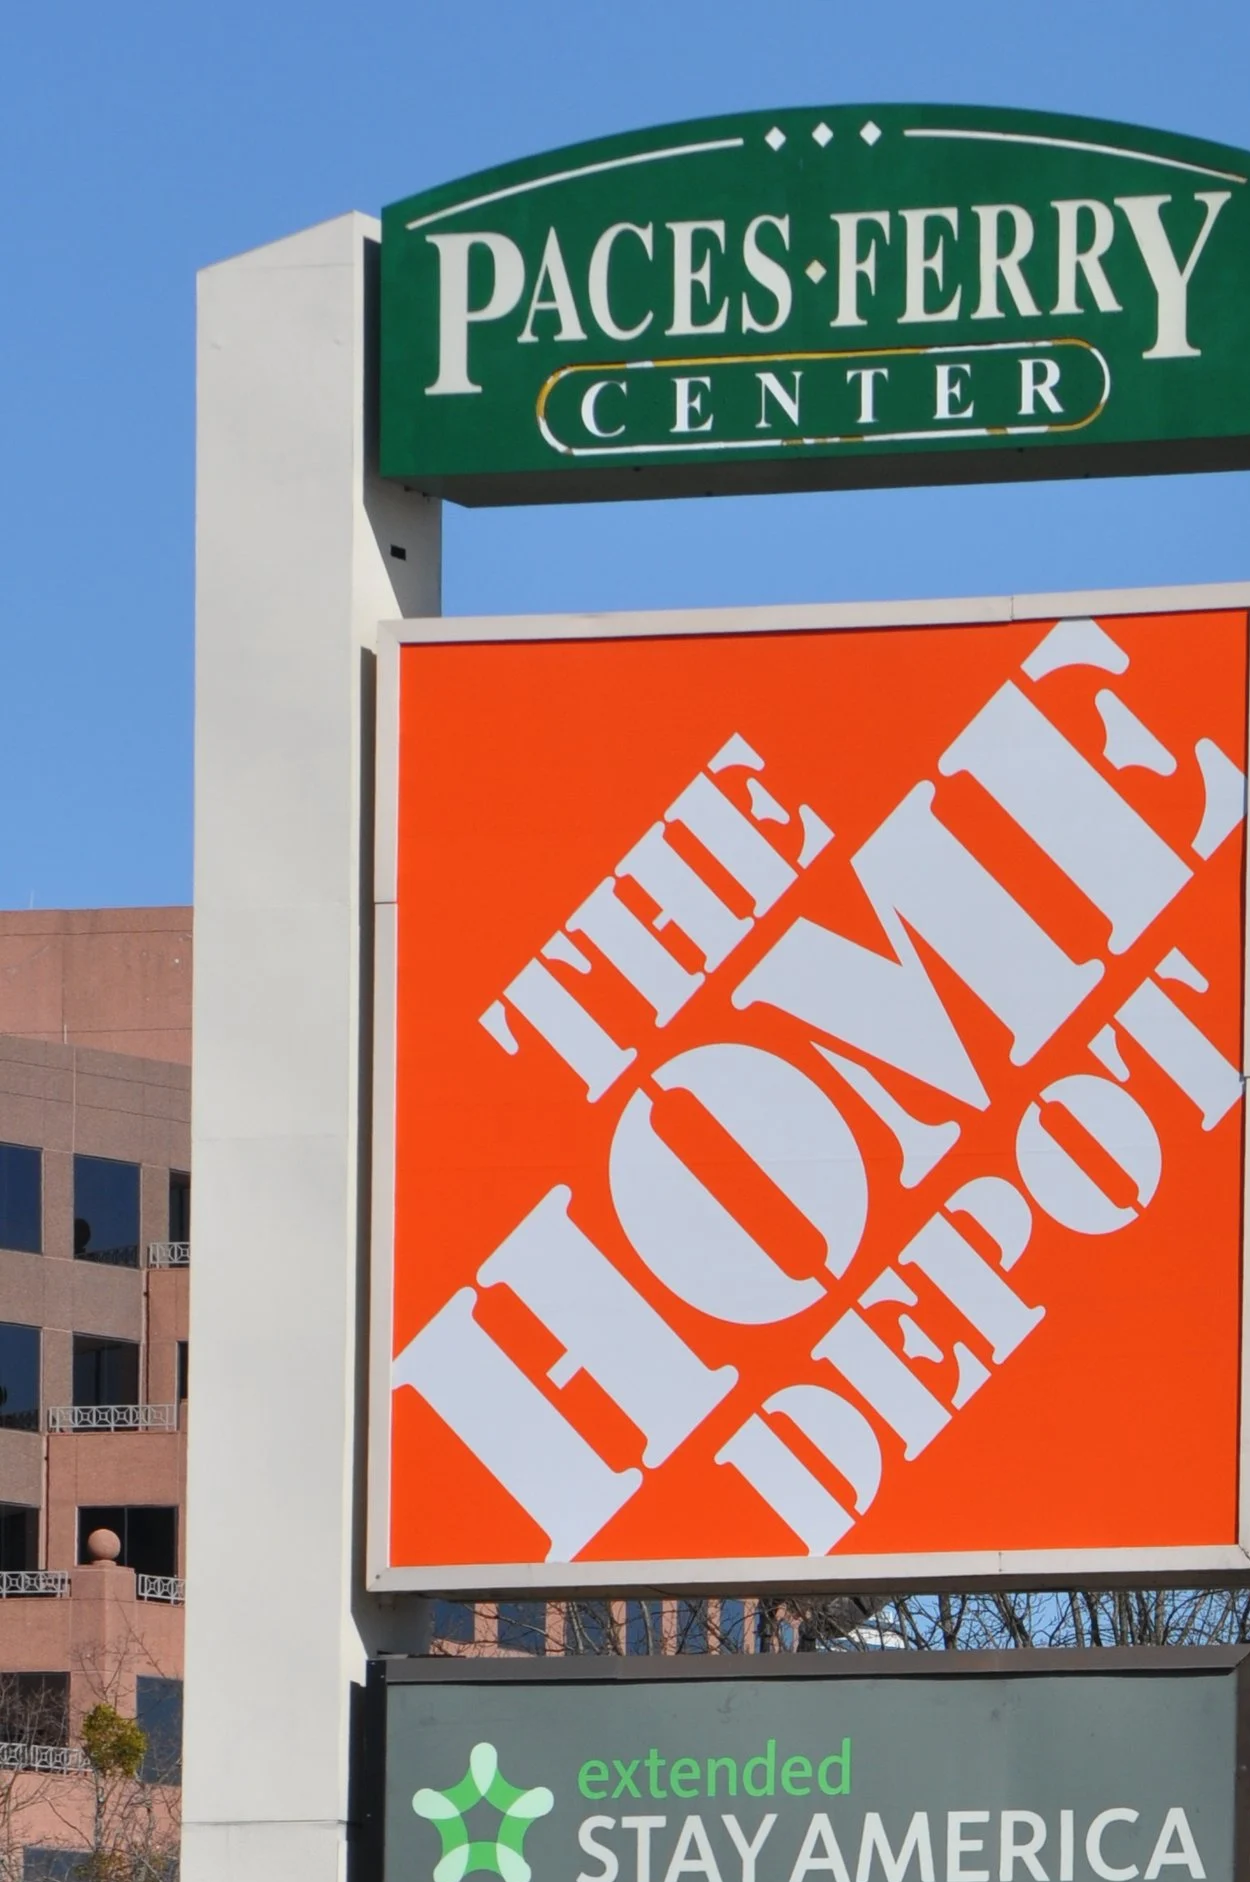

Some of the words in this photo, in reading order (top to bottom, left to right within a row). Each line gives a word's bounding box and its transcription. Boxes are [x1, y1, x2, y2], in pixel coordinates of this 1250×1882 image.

[426, 213, 793, 396] PACES
[830, 191, 1232, 359] FERRY
[580, 357, 1065, 439] CENTER
[479, 731, 836, 1103] THE
[390, 617, 1248, 1564] HOME
[714, 946, 1245, 1556] DEPOT
[577, 1737, 853, 1800] extended
